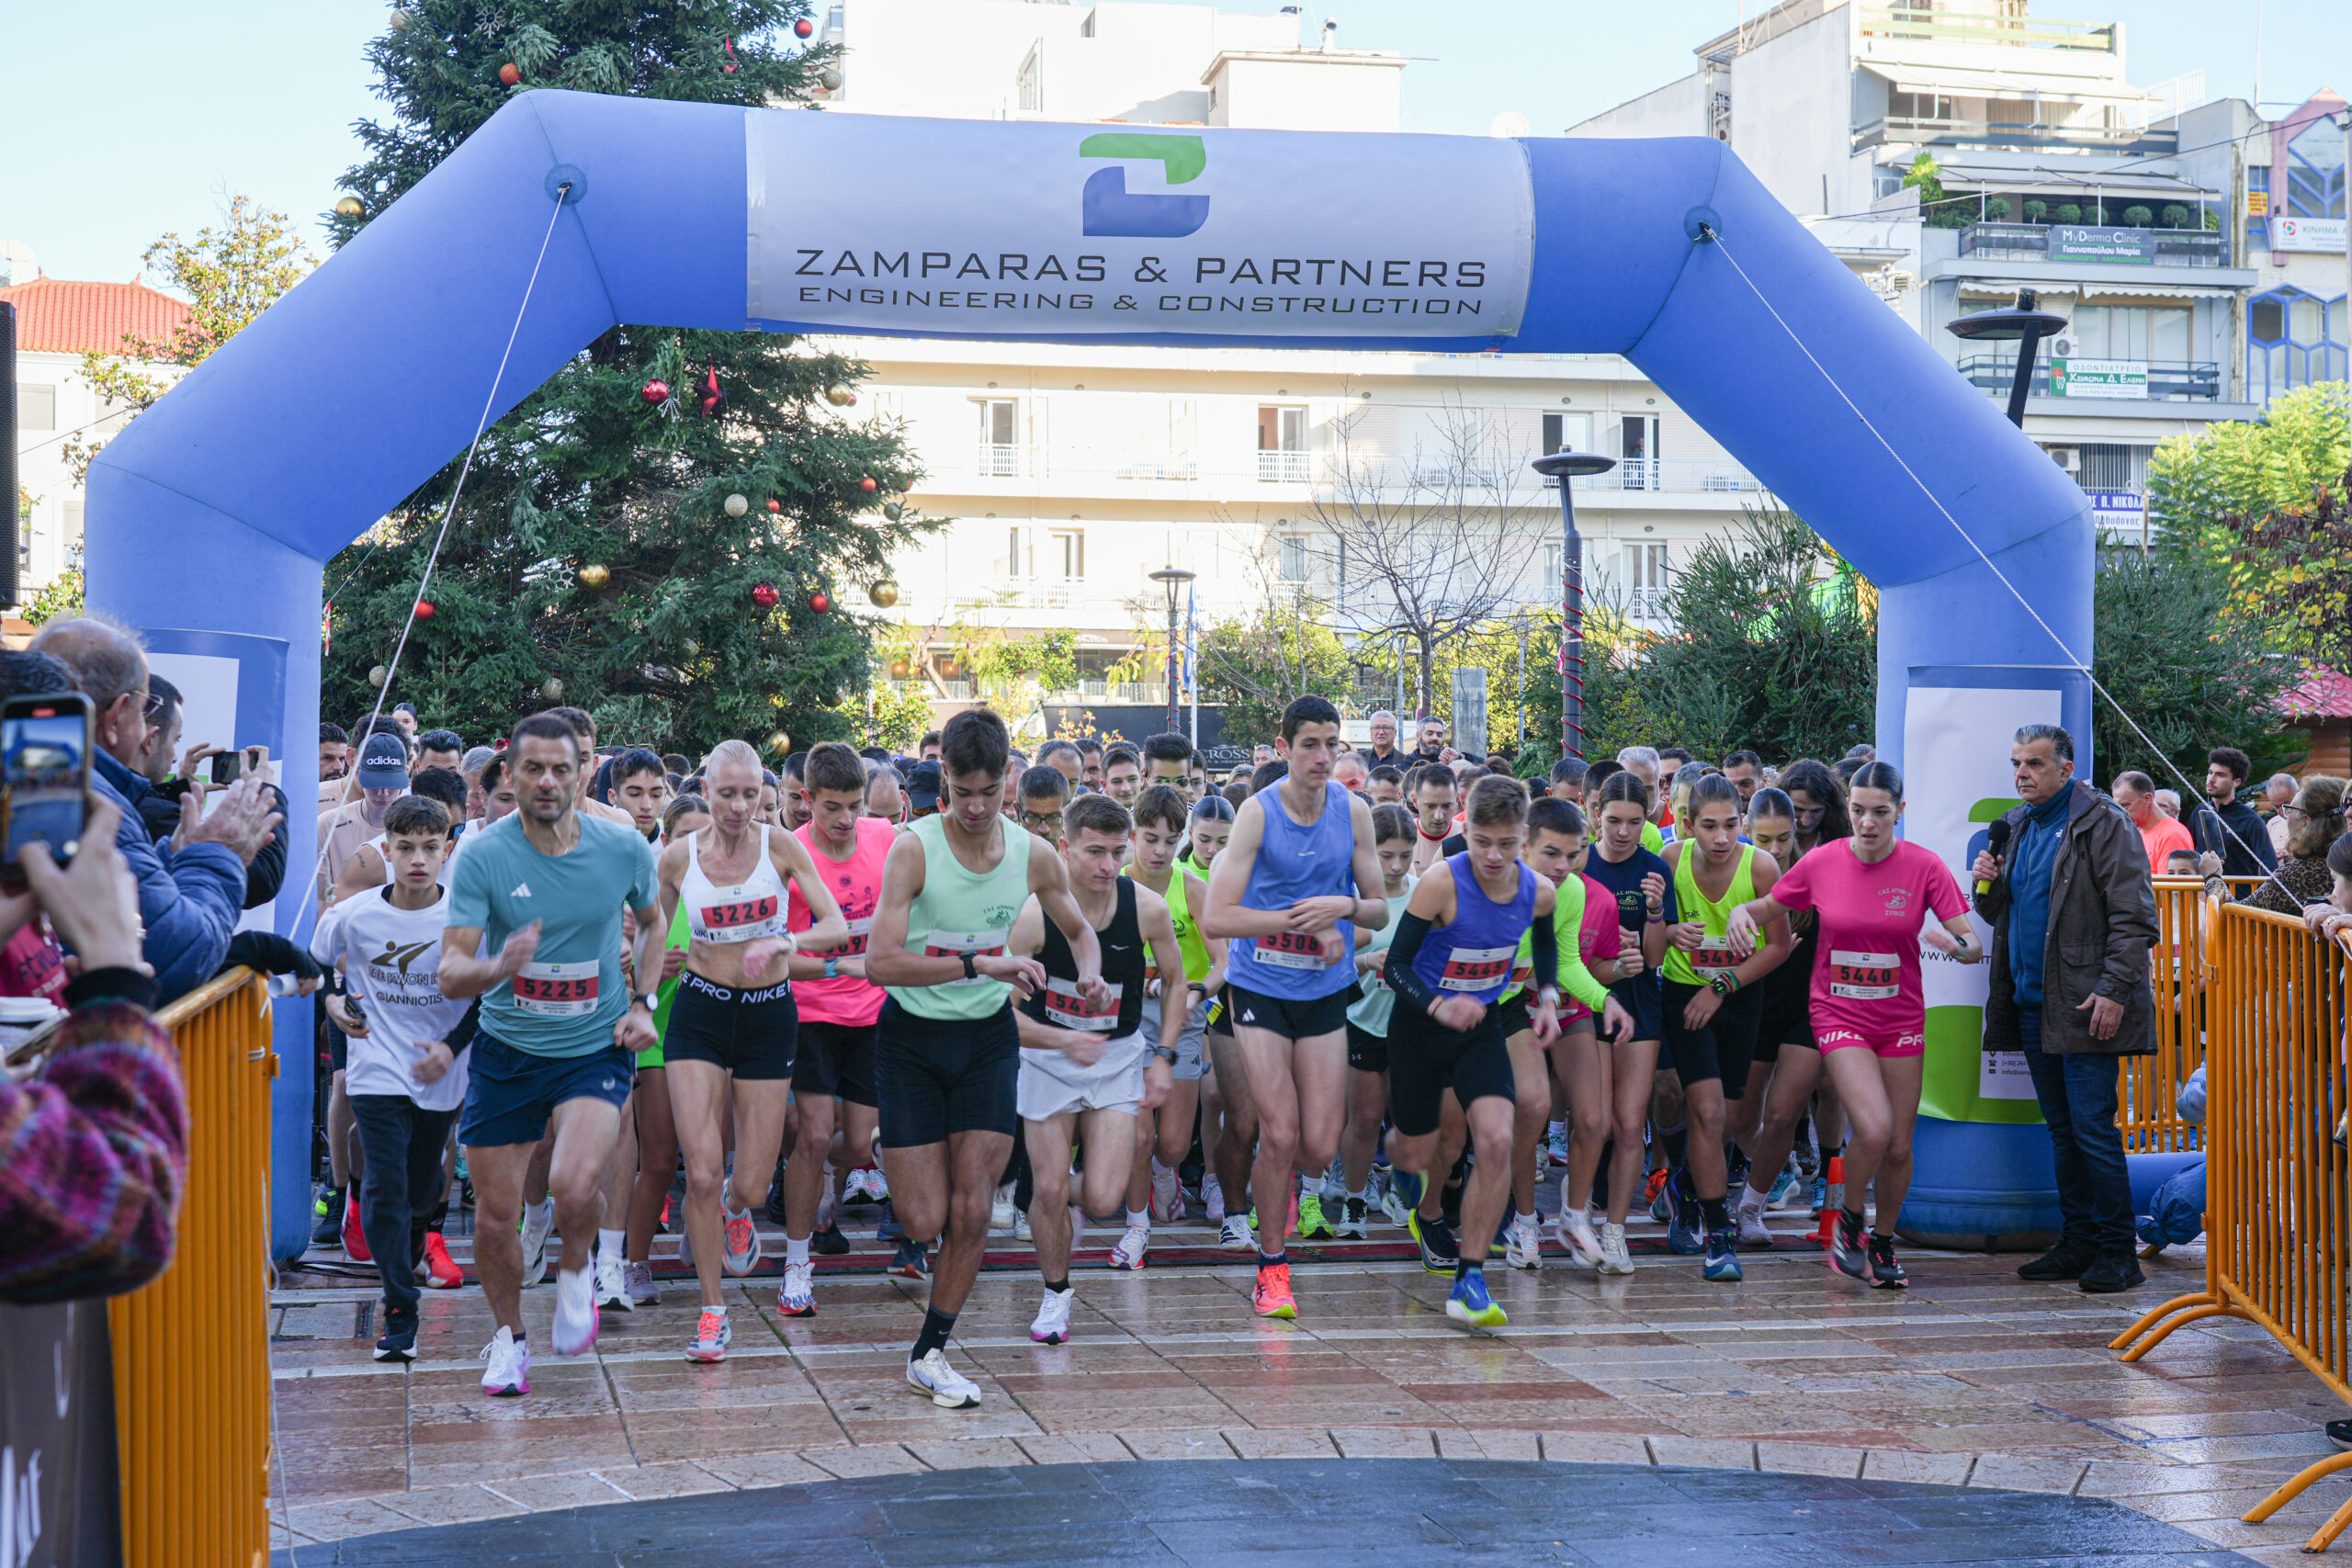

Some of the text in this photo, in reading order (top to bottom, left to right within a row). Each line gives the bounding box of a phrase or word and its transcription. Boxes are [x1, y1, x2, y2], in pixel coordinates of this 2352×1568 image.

[2113, 231, 2141, 244] Clinic
[2116, 246, 2141, 256] Μαρία
[795, 249, 1486, 288] ZAMPARAS & PARTNERS
[798, 287, 1482, 315] ENGINEERING & CONSTRUCTION
[2073, 364, 2141, 372] ΟΔΟΝΤΙΑΤΡΕΙΟ
[2101, 495, 2110, 508] Π.
[367, 755, 401, 766] adidas
[712, 898, 769, 924] 5226
[1267, 932, 1319, 953] 5508
[1454, 960, 1502, 977] 5445
[1840, 964, 1892, 984] 5440
[388, 971, 429, 986] KWON
[524, 978, 588, 998] 5225
[689, 977, 732, 1001] PRO
[741, 983, 786, 1004] NIKE
[376, 991, 443, 1007] GIANNIOTIS
